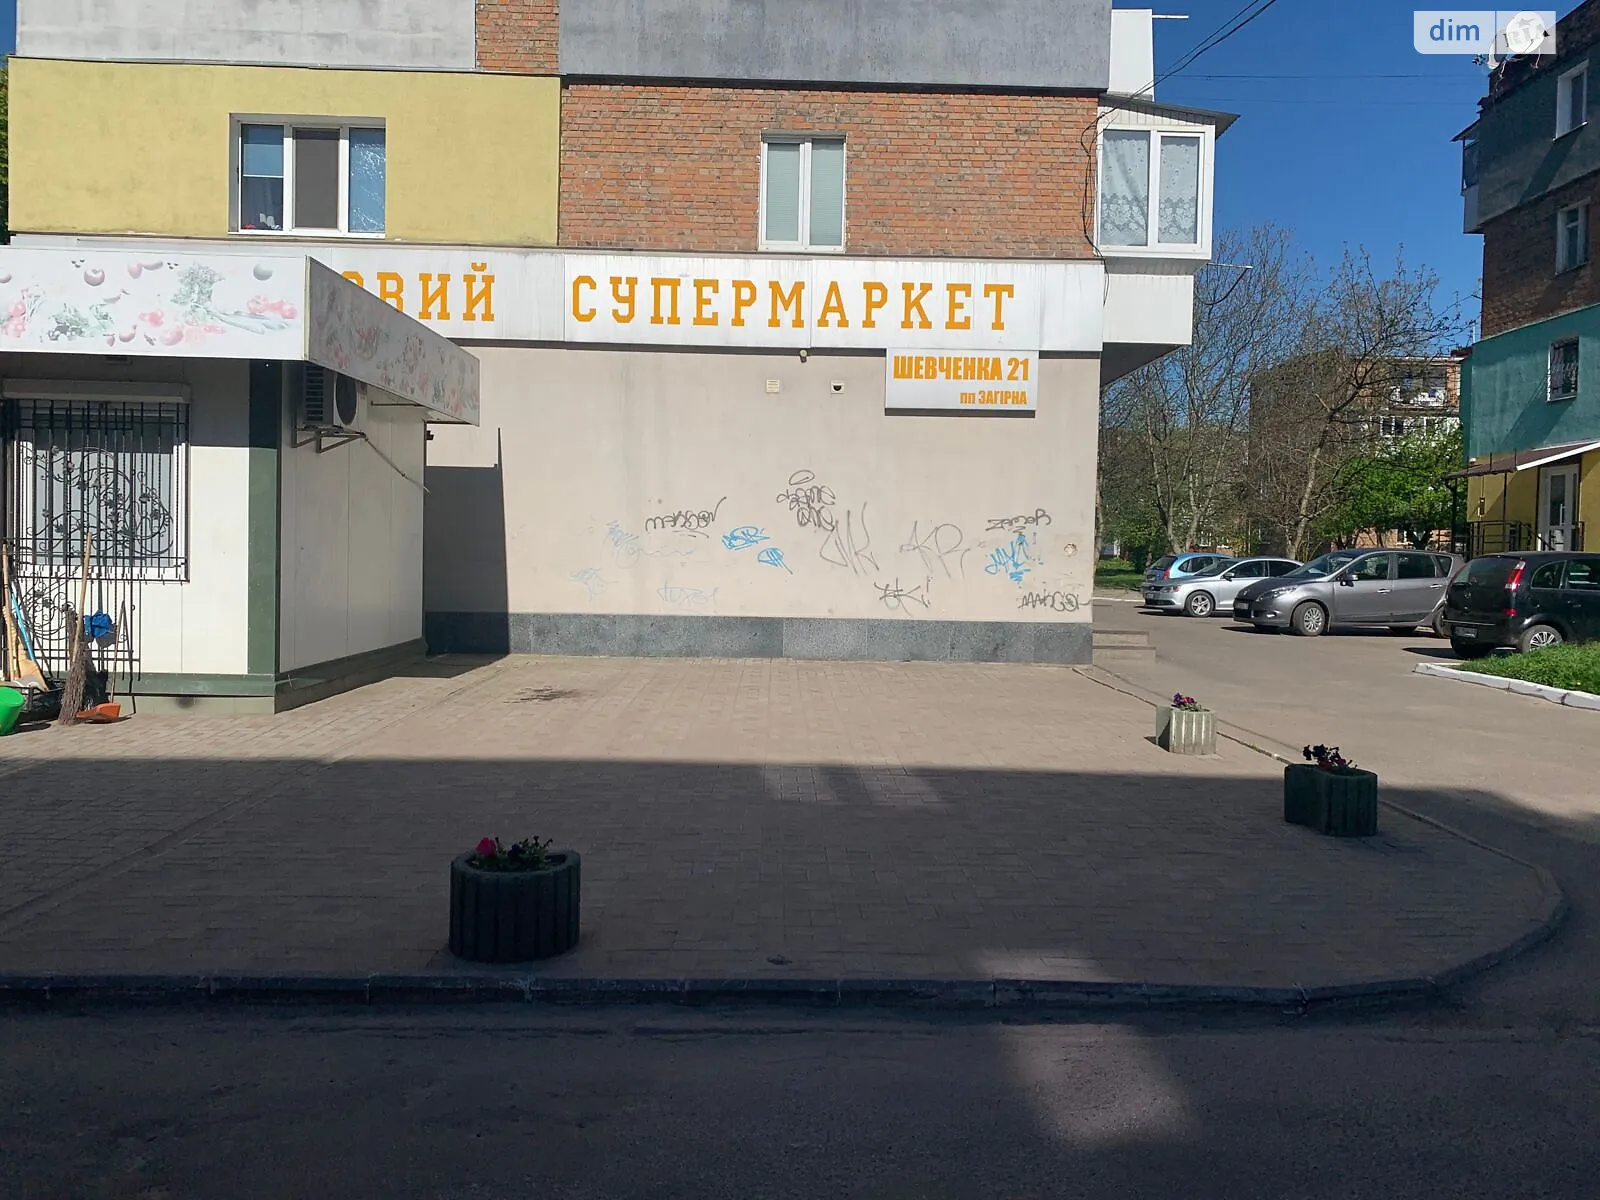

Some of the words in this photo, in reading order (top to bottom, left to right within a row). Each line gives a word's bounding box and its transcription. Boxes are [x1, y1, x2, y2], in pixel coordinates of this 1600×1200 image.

[572, 275, 1015, 331] СУПЕРМАРКЕТ
[893, 355, 1003, 381] ШЕВЧЕНКА
[1007, 357, 1029, 381] 21
[978, 390, 1027, 405] ЗАГІРНА
